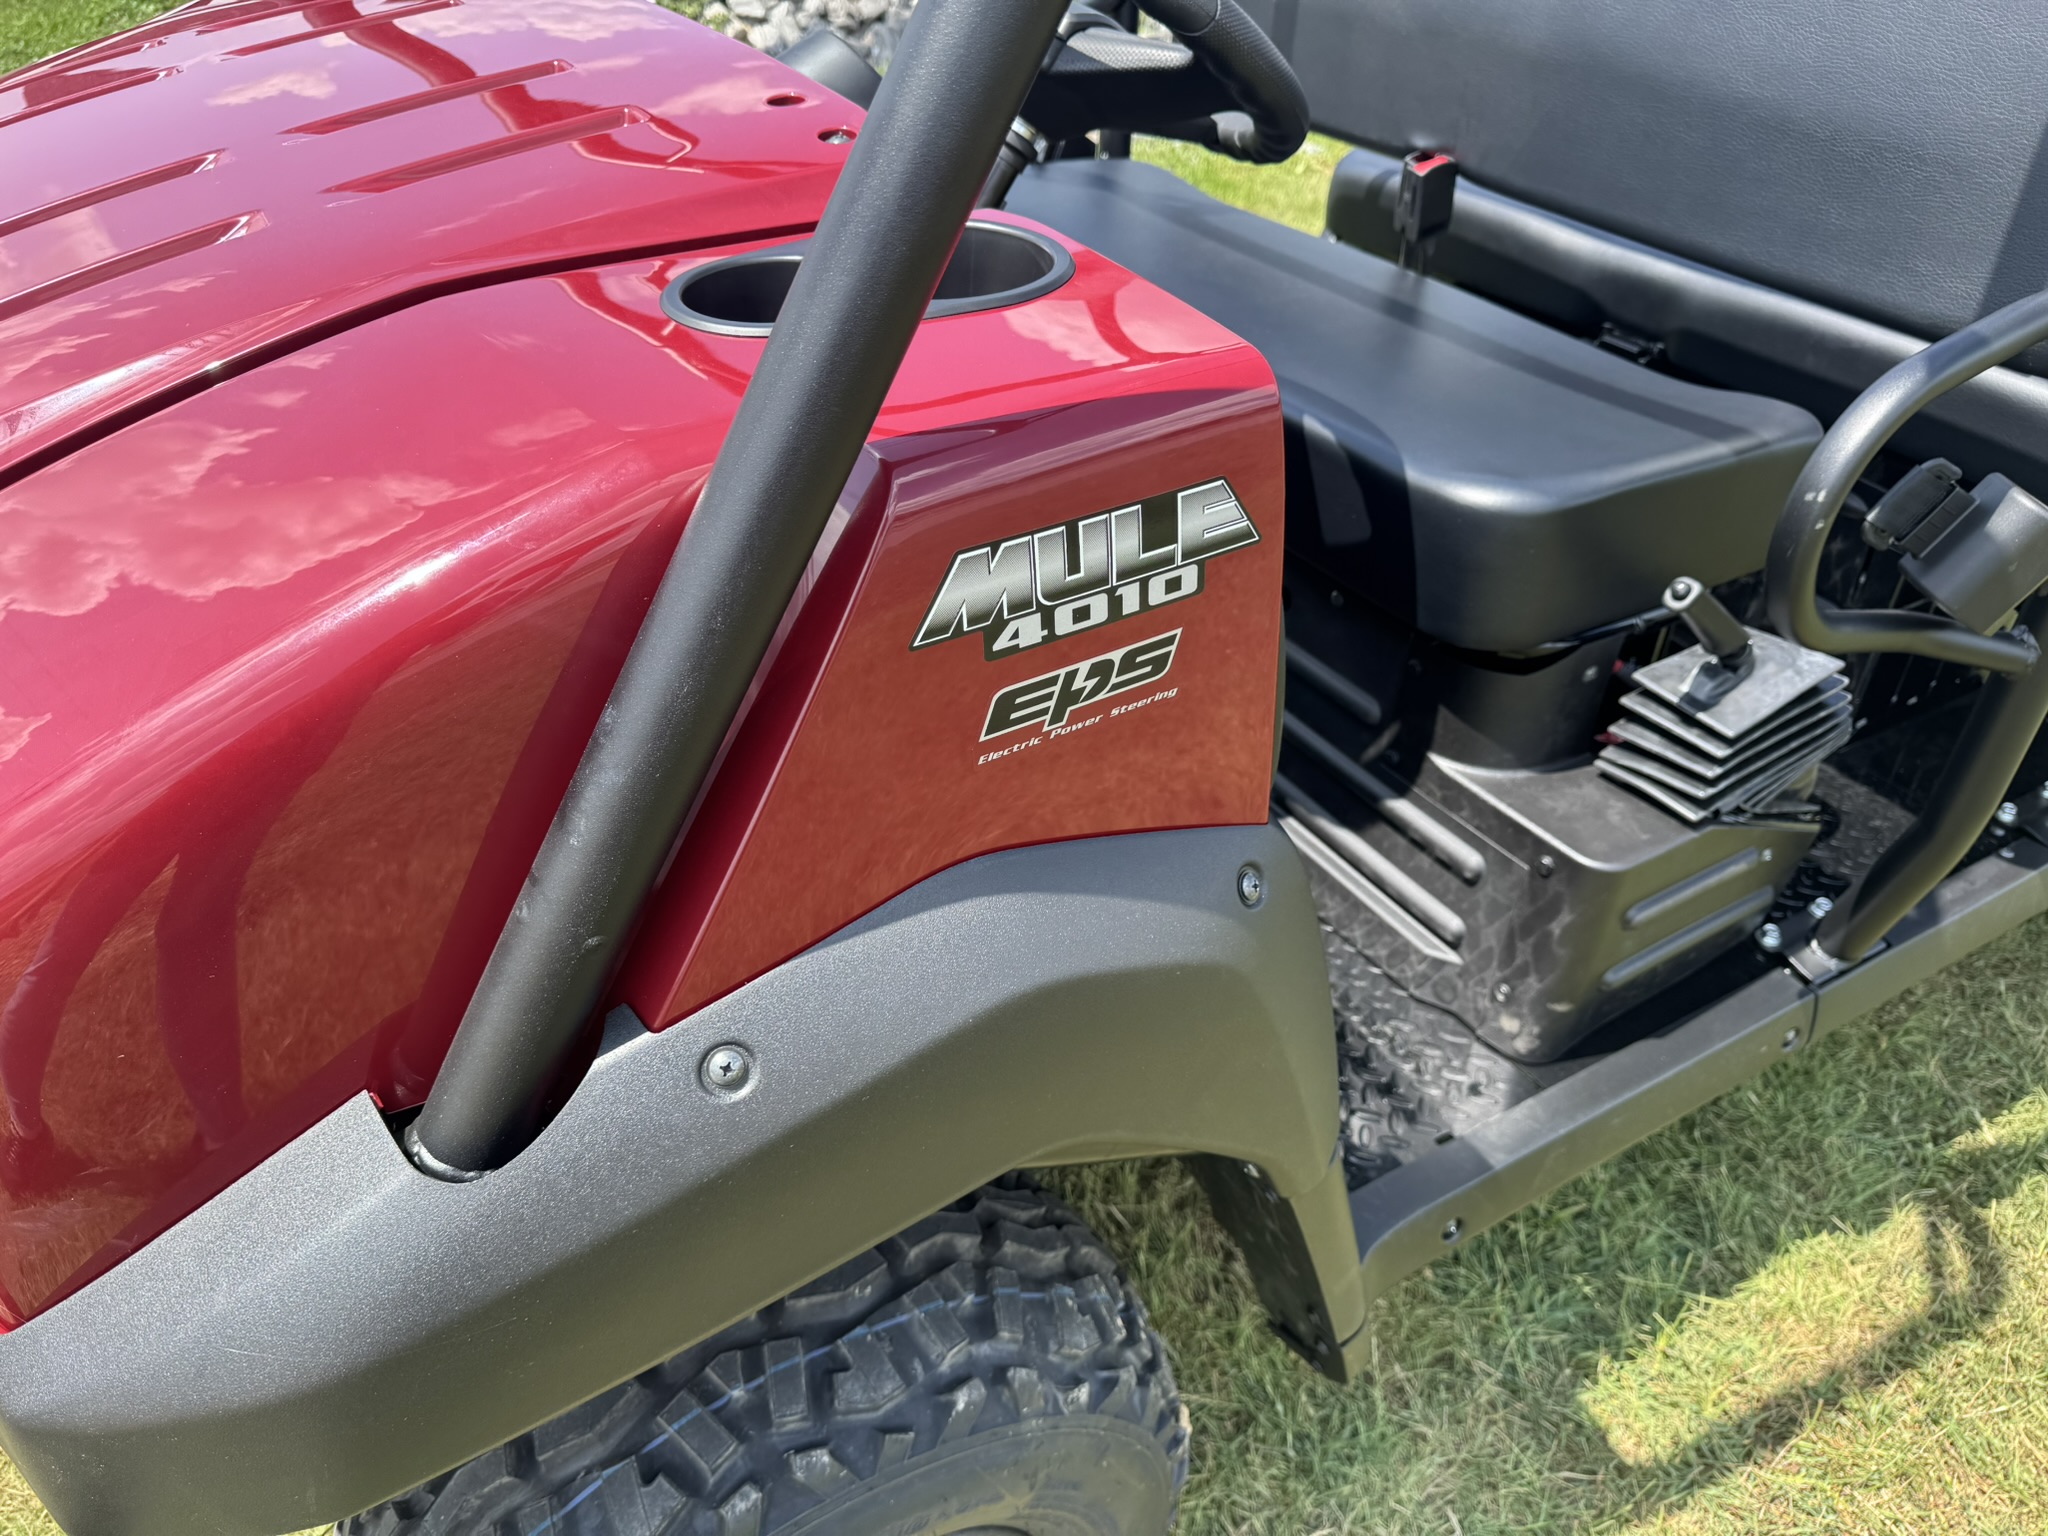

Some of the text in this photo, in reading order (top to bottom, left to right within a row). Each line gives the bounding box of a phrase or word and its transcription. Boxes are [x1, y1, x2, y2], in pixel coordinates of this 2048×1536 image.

[913, 479, 1260, 647] MULE
[992, 564, 1199, 652] 4010
[977, 687, 1178, 765] Electric Power Steering
[979, 627, 1183, 742] EPS
